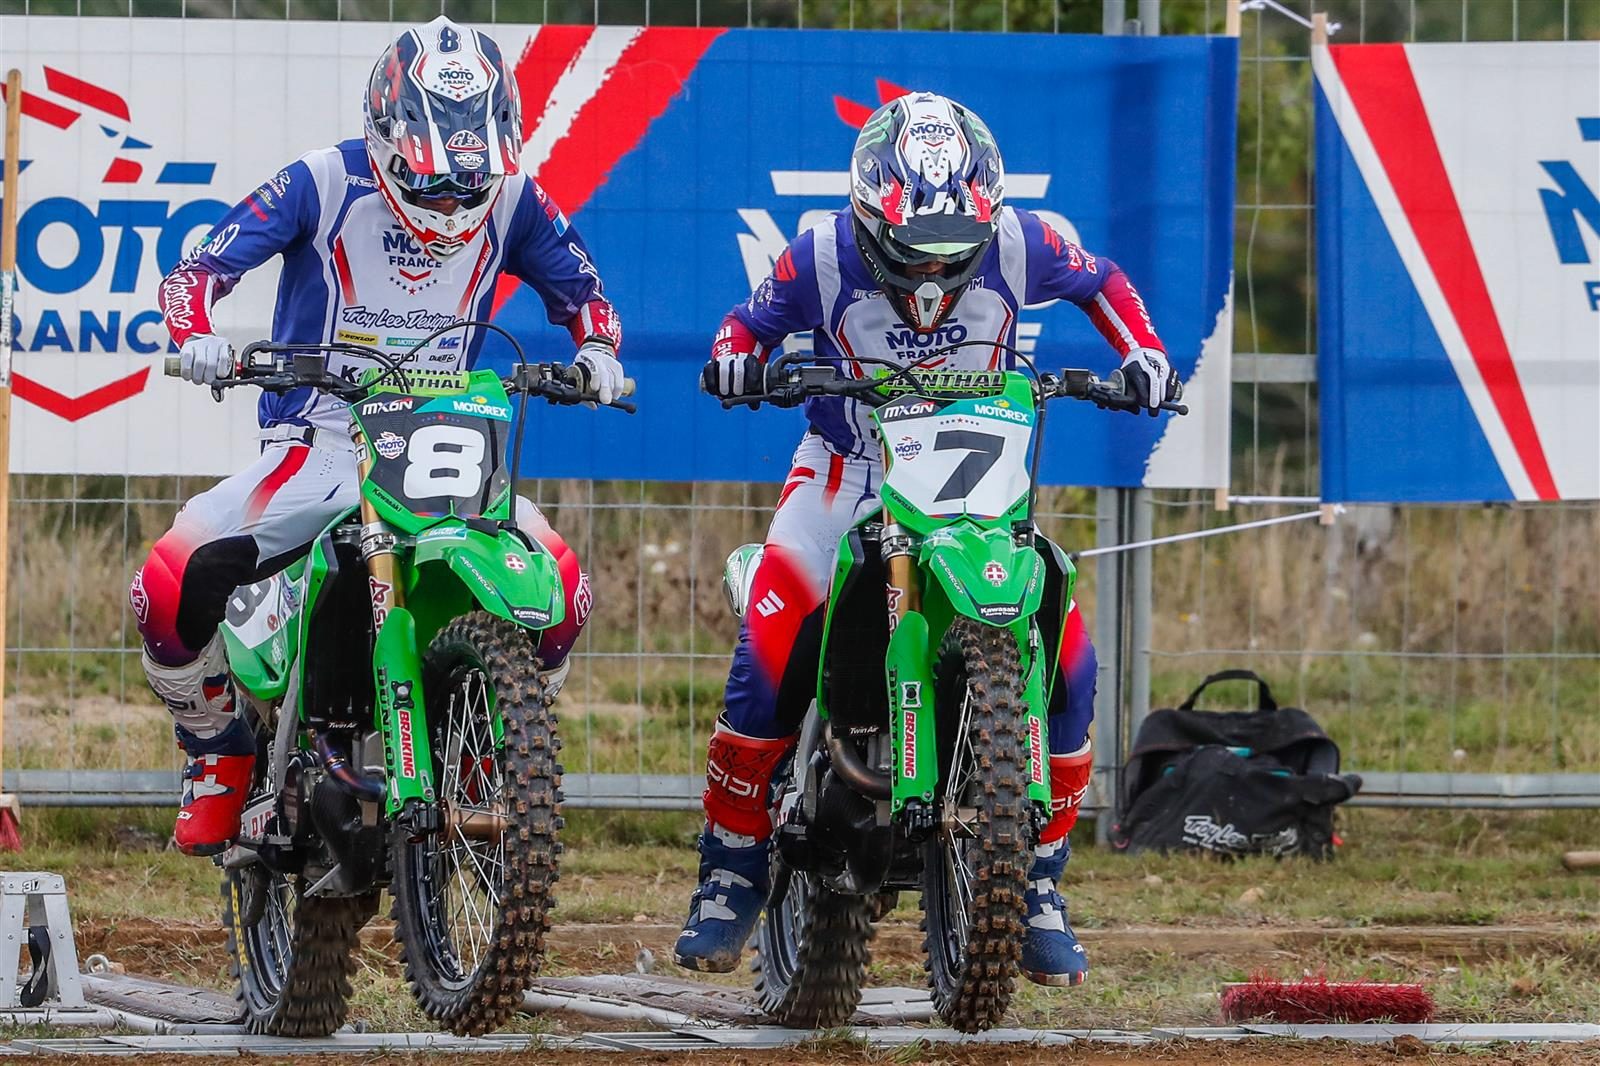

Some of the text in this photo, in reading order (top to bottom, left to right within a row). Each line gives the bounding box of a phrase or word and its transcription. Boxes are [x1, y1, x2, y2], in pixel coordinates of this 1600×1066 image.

[437, 26, 461, 53] 8
[438, 70, 475, 81] MOTO
[910, 123, 956, 136] MOTO
[454, 154, 485, 164] MOTO
[0, 196, 238, 295] OTO
[382, 231, 421, 255] MO
[388, 255, 442, 269] FRANCE
[343, 306, 465, 332] Troy Lee Designs
[11, 310, 182, 353] ANC
[343, 333, 376, 343] DUNLOP
[885, 322, 968, 350] MOTO
[896, 348, 958, 360] FRANCE
[380, 376, 465, 389] RENTHAL
[453, 400, 507, 418] MOTOREX
[974, 404, 1029, 423] MOTOREX
[376, 439, 405, 450] MOTO
[895, 442, 923, 454] MOTO
[402, 424, 486, 500] 8
[932, 429, 1006, 503] 7
[372, 487, 402, 513] Kawasaki
[889, 491, 917, 515] Kawasaki
[513, 609, 550, 621] Kawasaki
[980, 606, 1019, 616] Kawasaki
[850, 725, 879, 735] Twin Air
[399, 709, 415, 778] BRAKING
[903, 711, 916, 779] BRAKING
[1028, 716, 1044, 784] BRAKING
[708, 760, 760, 799] SIDI
